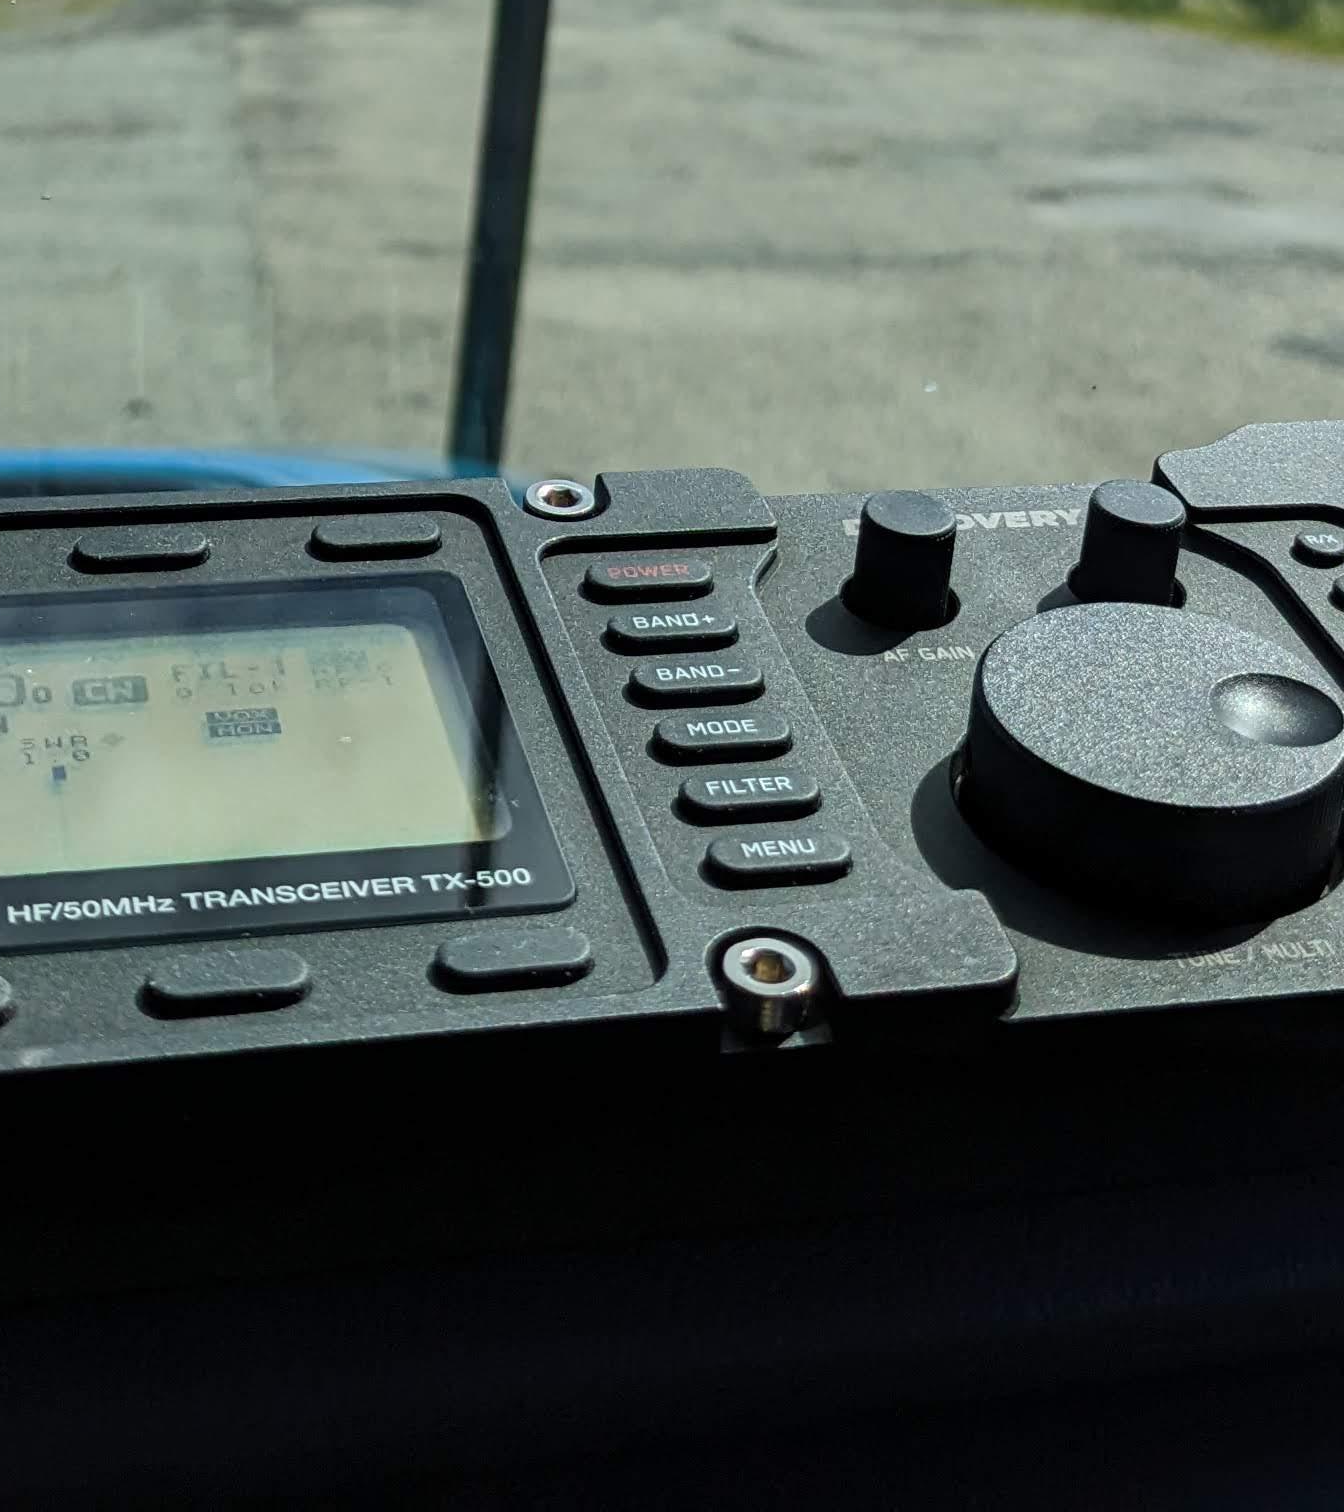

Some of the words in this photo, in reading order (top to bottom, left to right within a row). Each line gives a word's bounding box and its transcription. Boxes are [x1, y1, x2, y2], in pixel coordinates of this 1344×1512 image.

[1305, 533, 1338, 544] R/X
[607, 561, 690, 579] POWER
[632, 612, 715, 630] BAND+
[883, 651, 909, 662] AF
[920, 646, 975, 662] GAIN
[656, 665, 740, 682] BAND-
[686, 719, 758, 735] MODE
[706, 775, 793, 792] FILTER
[741, 838, 816, 857] MENU
[6, 895, 175, 925] HF/50MHz
[182, 876, 416, 910] TRANSCEIVER
[421, 866, 532, 890] TX-500
